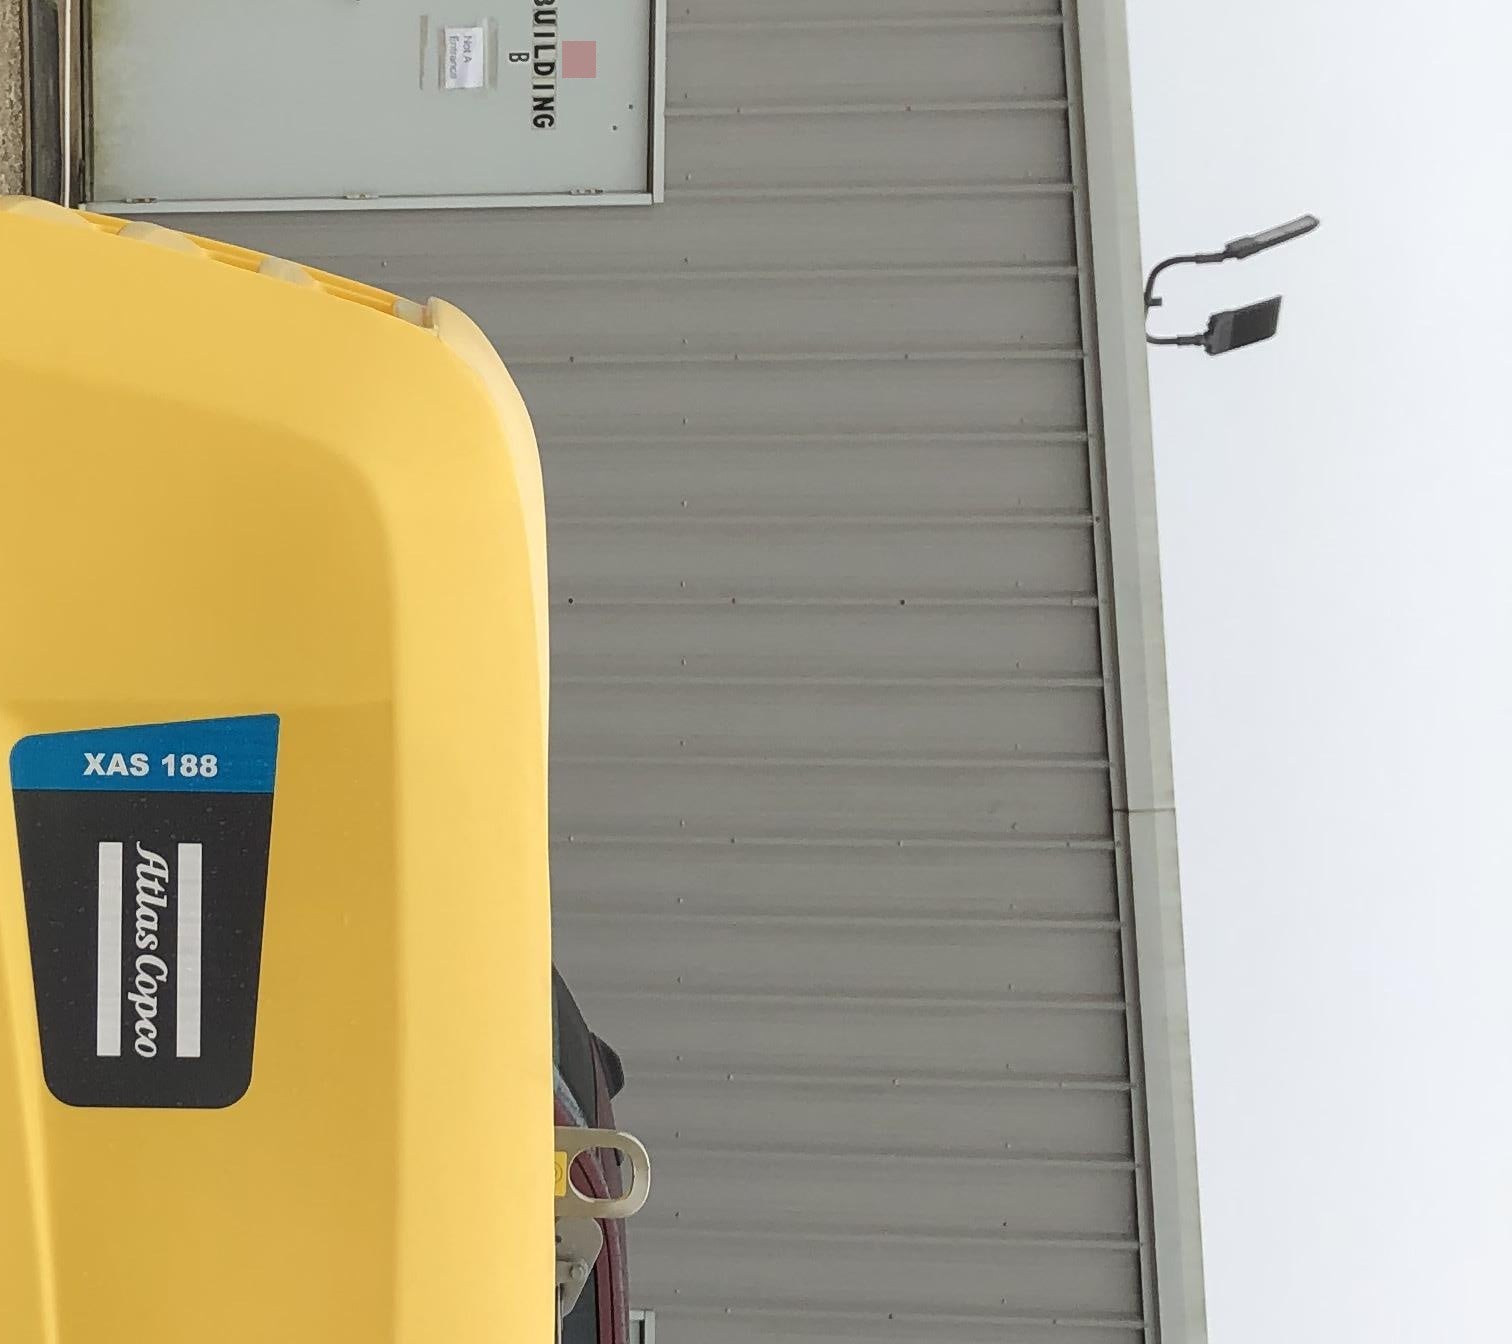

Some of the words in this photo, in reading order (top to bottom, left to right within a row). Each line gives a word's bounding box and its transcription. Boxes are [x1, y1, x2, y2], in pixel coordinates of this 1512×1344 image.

[508, 52, 529, 63] B
[82, 752, 149, 778] XAS
[161, 753, 219, 778] 188
[133, 841, 169, 950] Atlas
[127, 954, 168, 1058] Copco
